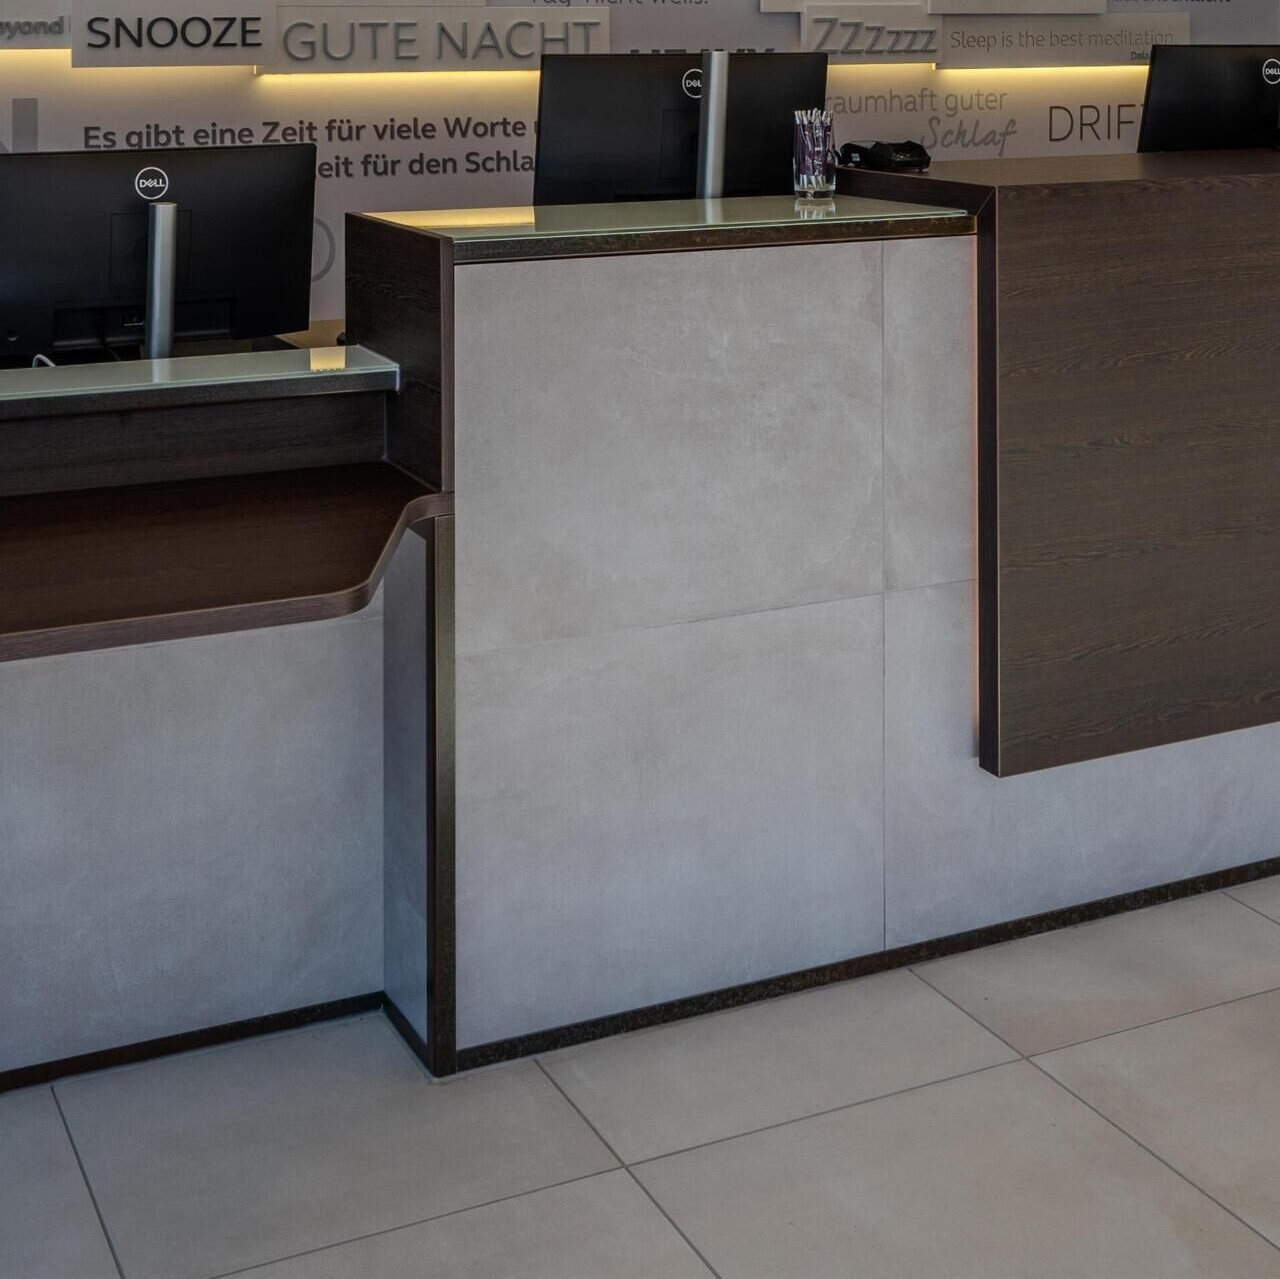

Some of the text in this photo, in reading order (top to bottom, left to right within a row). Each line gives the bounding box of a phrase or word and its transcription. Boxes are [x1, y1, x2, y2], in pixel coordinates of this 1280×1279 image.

[86, 16, 263, 50] SNOOZE
[282, 20, 601, 64] GUTE NACHT
[949, 30, 998, 53] Sleep
[1001, 30, 1014, 49] is
[1017, 28, 1046, 48] the
[1049, 29, 1085, 48] best
[1129, 50, 1150, 61] Dala
[944, 88, 1008, 119] guter
[83, 125, 117, 150] Es
[124, 123, 186, 150] gibt
[192, 121, 255, 147] eine
[261, 119, 318, 146] Zeit
[324, 118, 367, 143] für
[372, 116, 437, 141] viele
[442, 116, 527, 139] Worte
[920, 114, 1019, 159] Schlaf
[1048, 103, 1146, 145] DRIF
[317, 149, 535, 180] eit für den Schla
